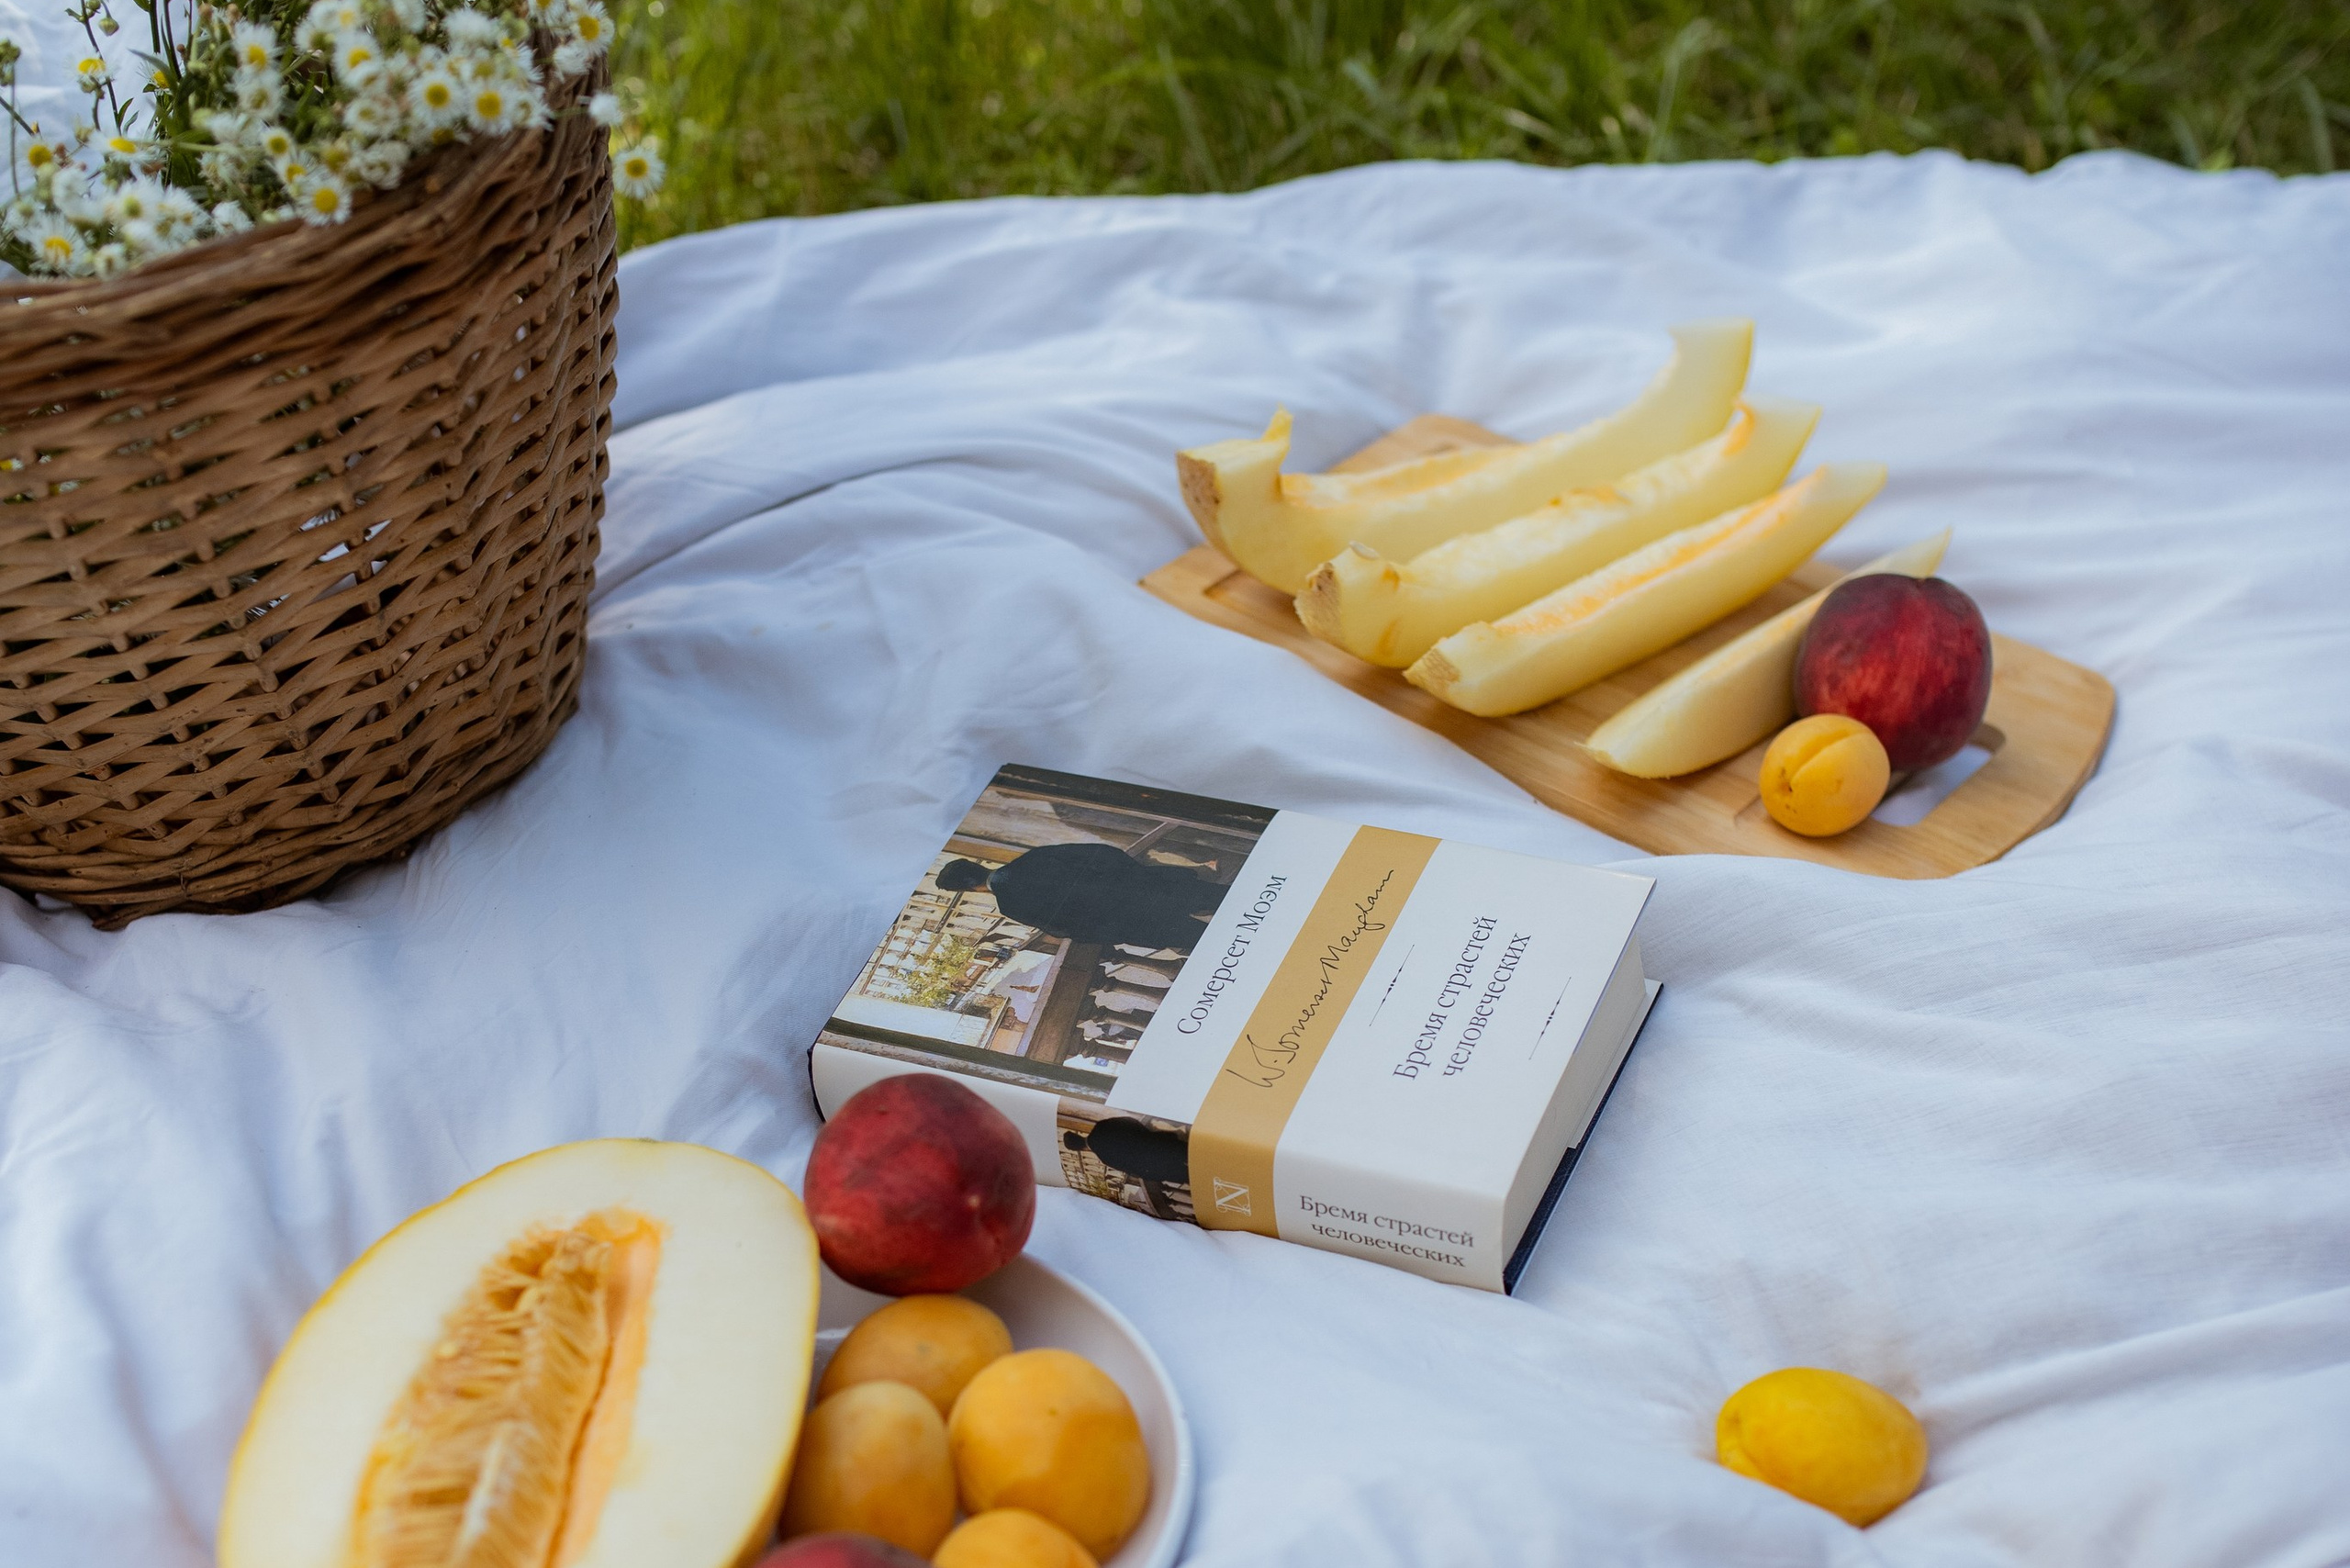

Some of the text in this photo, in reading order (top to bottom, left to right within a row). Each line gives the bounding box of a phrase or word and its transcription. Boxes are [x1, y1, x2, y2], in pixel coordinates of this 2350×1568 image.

[1177, 875, 1287, 1035] Сомерсет Моэм
[1393, 916, 1498, 1081] Бремя страстей
[1442, 933, 1531, 1078] человеческих
[1299, 1194, 1474, 1248] Бремя страстей
[1311, 1222, 1466, 1268] человеческих
